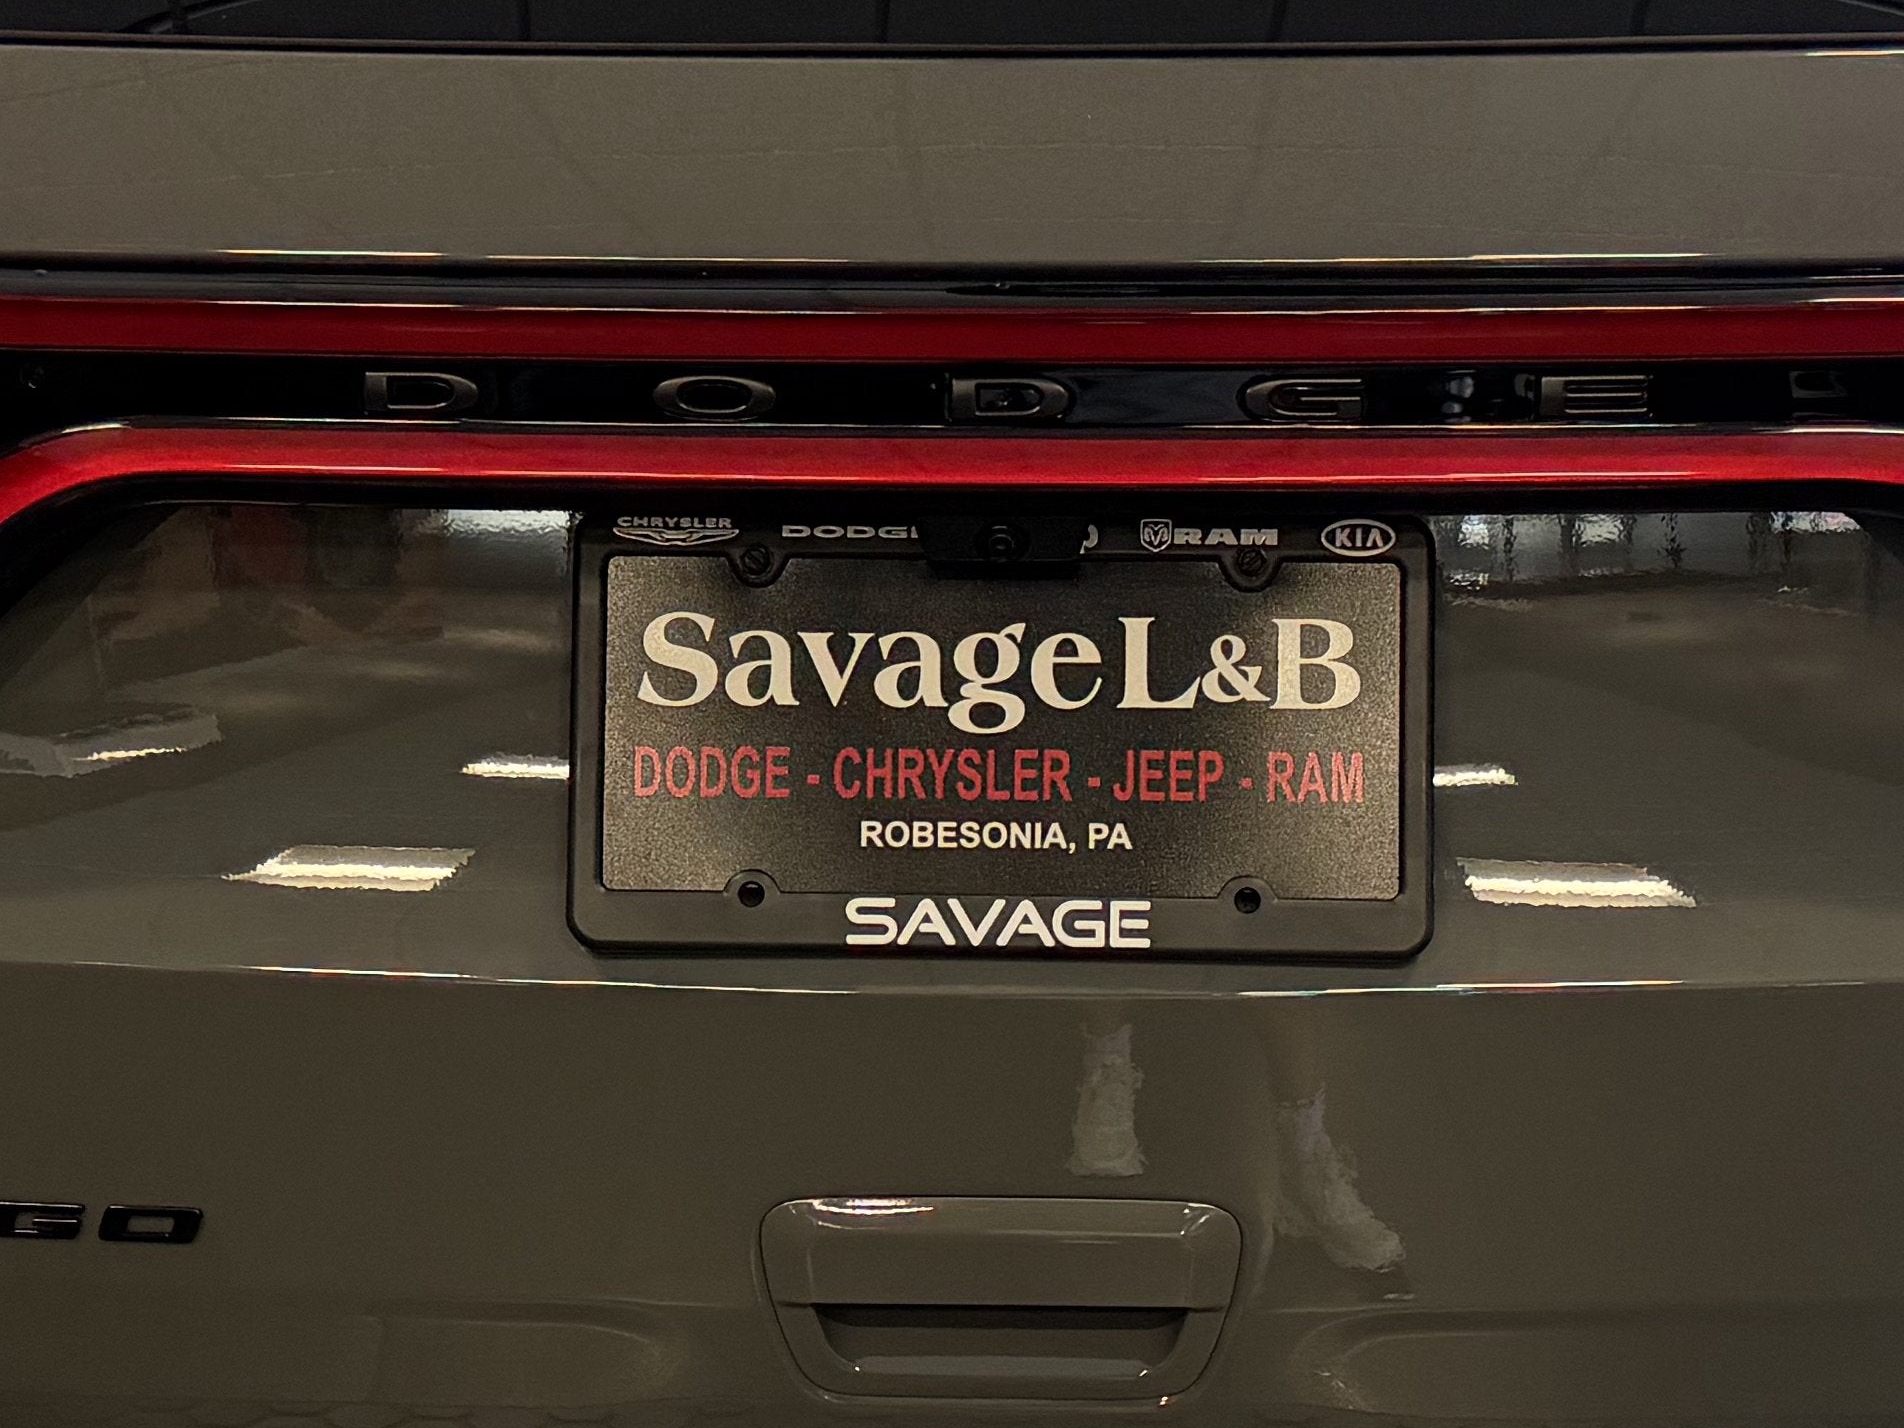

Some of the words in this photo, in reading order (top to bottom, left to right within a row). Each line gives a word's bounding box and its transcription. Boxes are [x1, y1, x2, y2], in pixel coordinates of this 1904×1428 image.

[364, 371, 1652, 423] DODGE
[616, 516, 733, 529] CHRYSLER
[781, 524, 919, 539] DODG
[1173, 528, 1279, 546] RAM
[1334, 527, 1384, 548] KIA
[637, 611, 1103, 735] Savage
[1117, 617, 1362, 711] L&B
[633, 745, 791, 799] DODGE
[834, 749, 1072, 804] CHRYSLER
[1112, 750, 1225, 803] JEEP
[1266, 751, 1366, 804] RAM
[860, 821, 1077, 855] ROBESONIA,
[1089, 823, 1133, 851] PA
[845, 898, 1152, 949] SAVAGE
